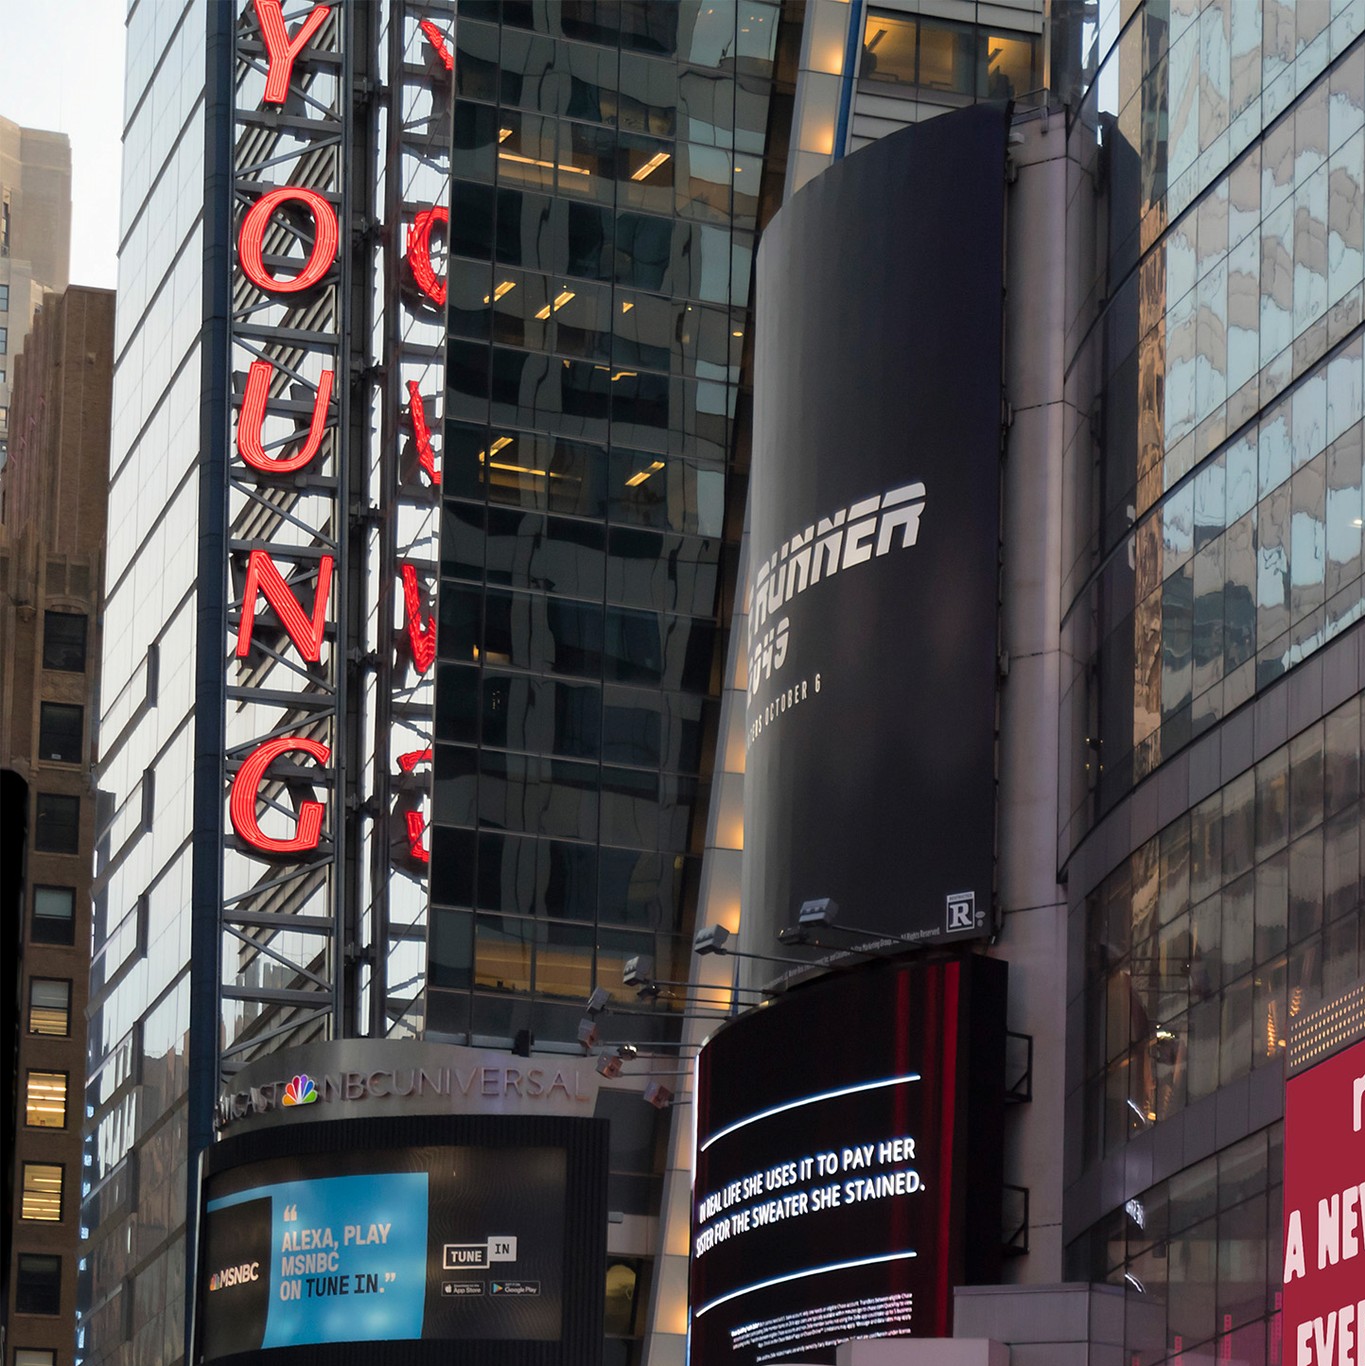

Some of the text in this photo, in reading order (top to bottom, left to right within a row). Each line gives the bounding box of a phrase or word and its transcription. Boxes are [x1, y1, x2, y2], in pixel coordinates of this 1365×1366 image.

[230, 0, 338, 853] YOUNG
[753, 481, 927, 637] RUNNER
[764, 673, 821, 726] OCTOBER 6
[949, 901, 973, 928] R
[322, 1066, 590, 1103] NBCUNIVERSAL
[706, 1136, 916, 1219] REAL LIFE SHE USES IT TO PAY HER
[696, 1170, 927, 1259] SISTER FOR THE SWEATER SHE STAINED.
[281, 1223, 392, 1253] ALEXA, PLAY
[451, 1243, 510, 1263] TUNE IN
[1283, 1208, 1306, 1284] A
[219, 1260, 260, 1288] MSNBC
[281, 1251, 339, 1277] MSNBC
[280, 1279, 302, 1302] ON
[306, 1274, 350, 1299] TUNE
[453, 1287, 466, 1295] App
[504, 1287, 537, 1295] Google Play
